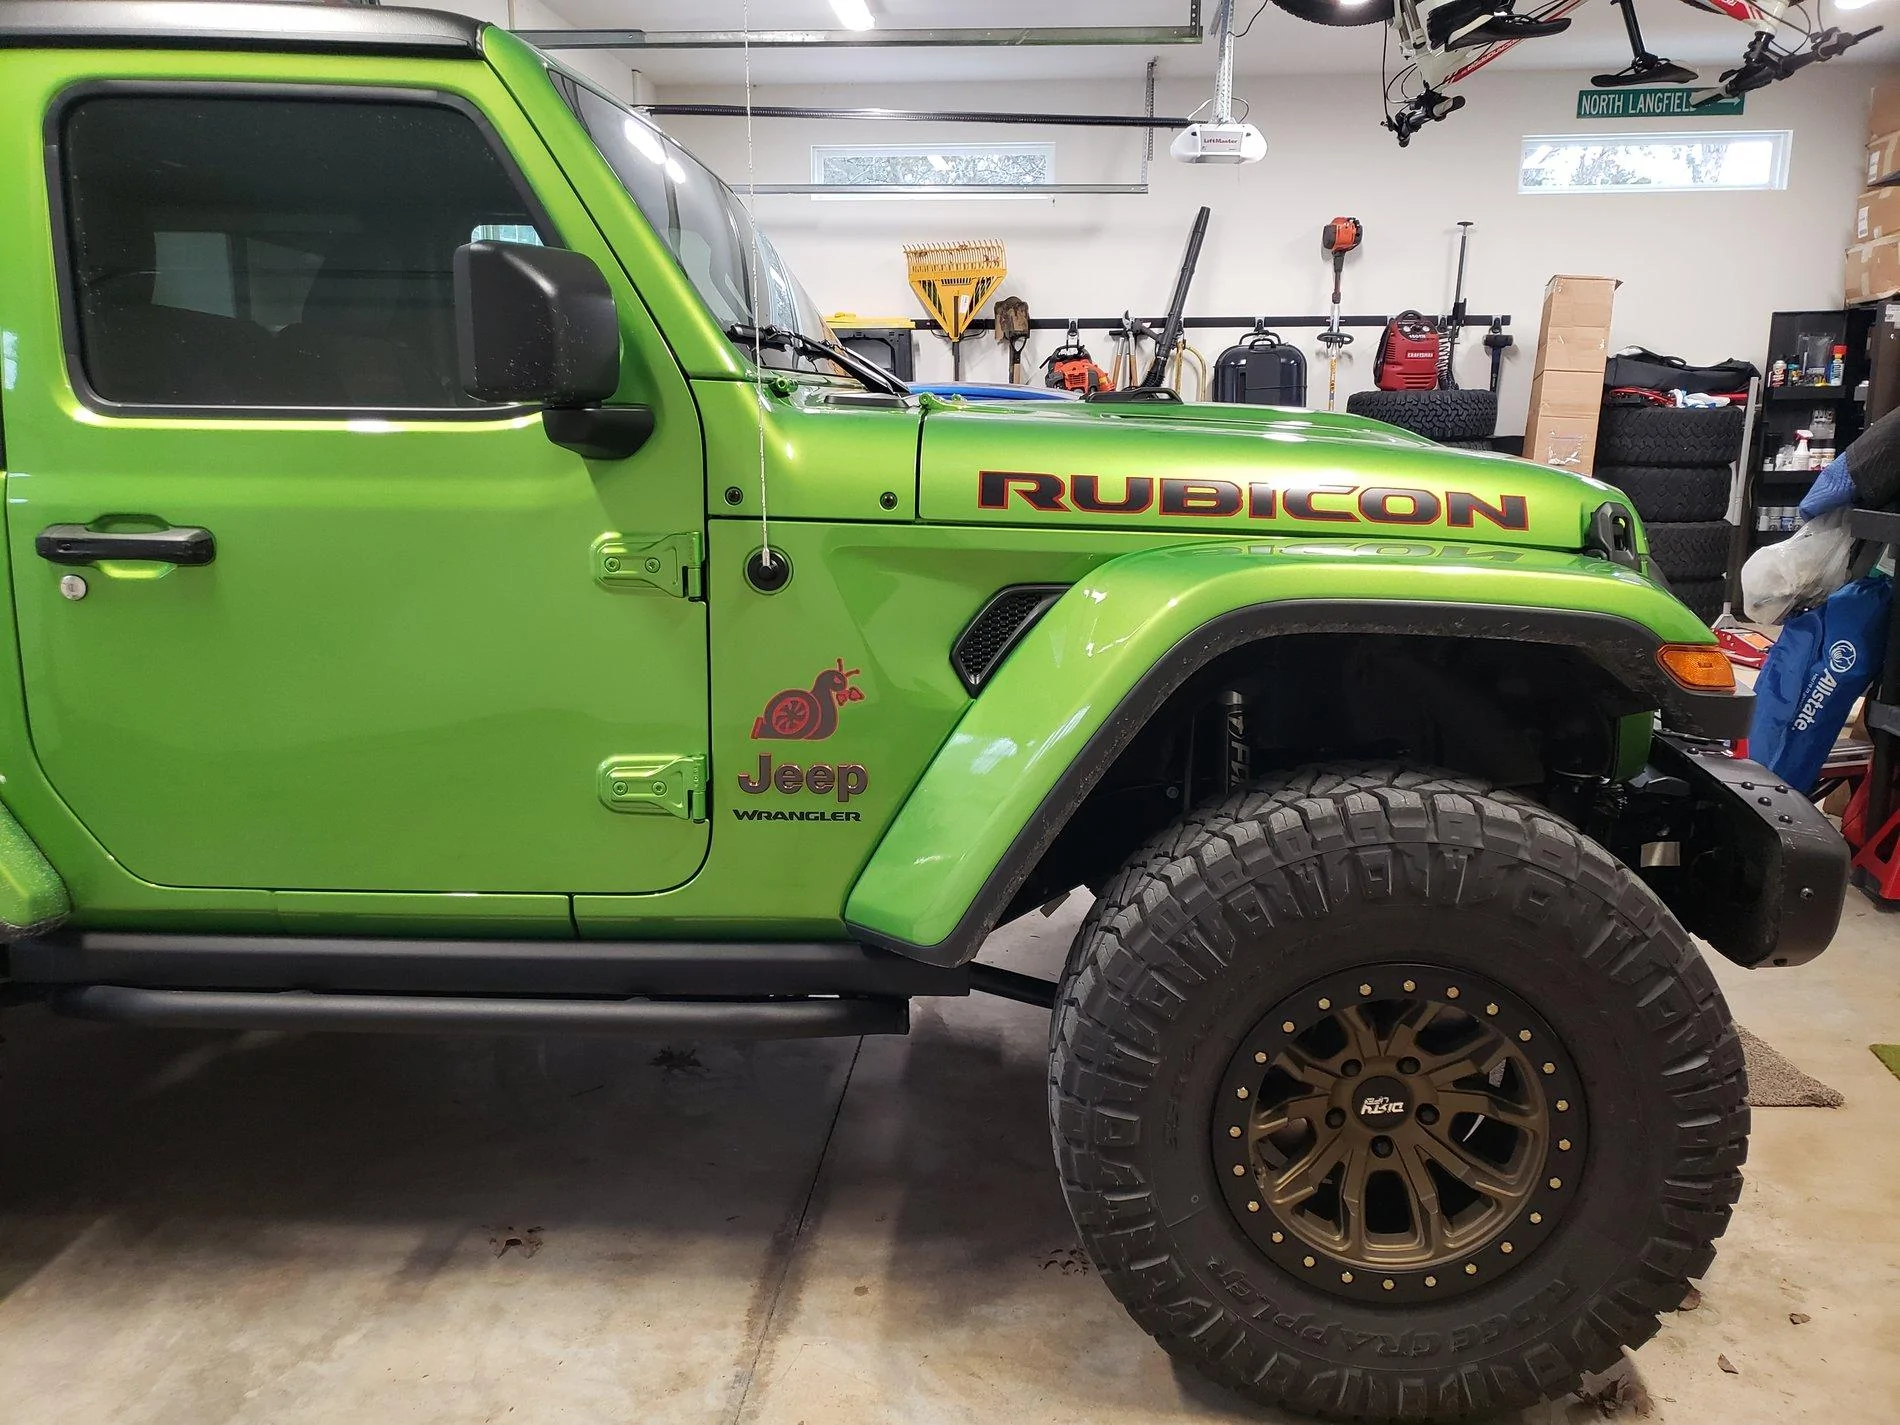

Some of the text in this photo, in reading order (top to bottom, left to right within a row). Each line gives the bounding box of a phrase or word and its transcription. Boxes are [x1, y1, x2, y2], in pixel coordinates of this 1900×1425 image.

[1581, 92, 1697, 115] NORTH LANGFIEL
[978, 471, 1529, 531] RUBICON
[737, 752, 869, 802] Jeep
[732, 809, 862, 821] WRANGLER
[1360, 1101, 1404, 1115] DIRTY
